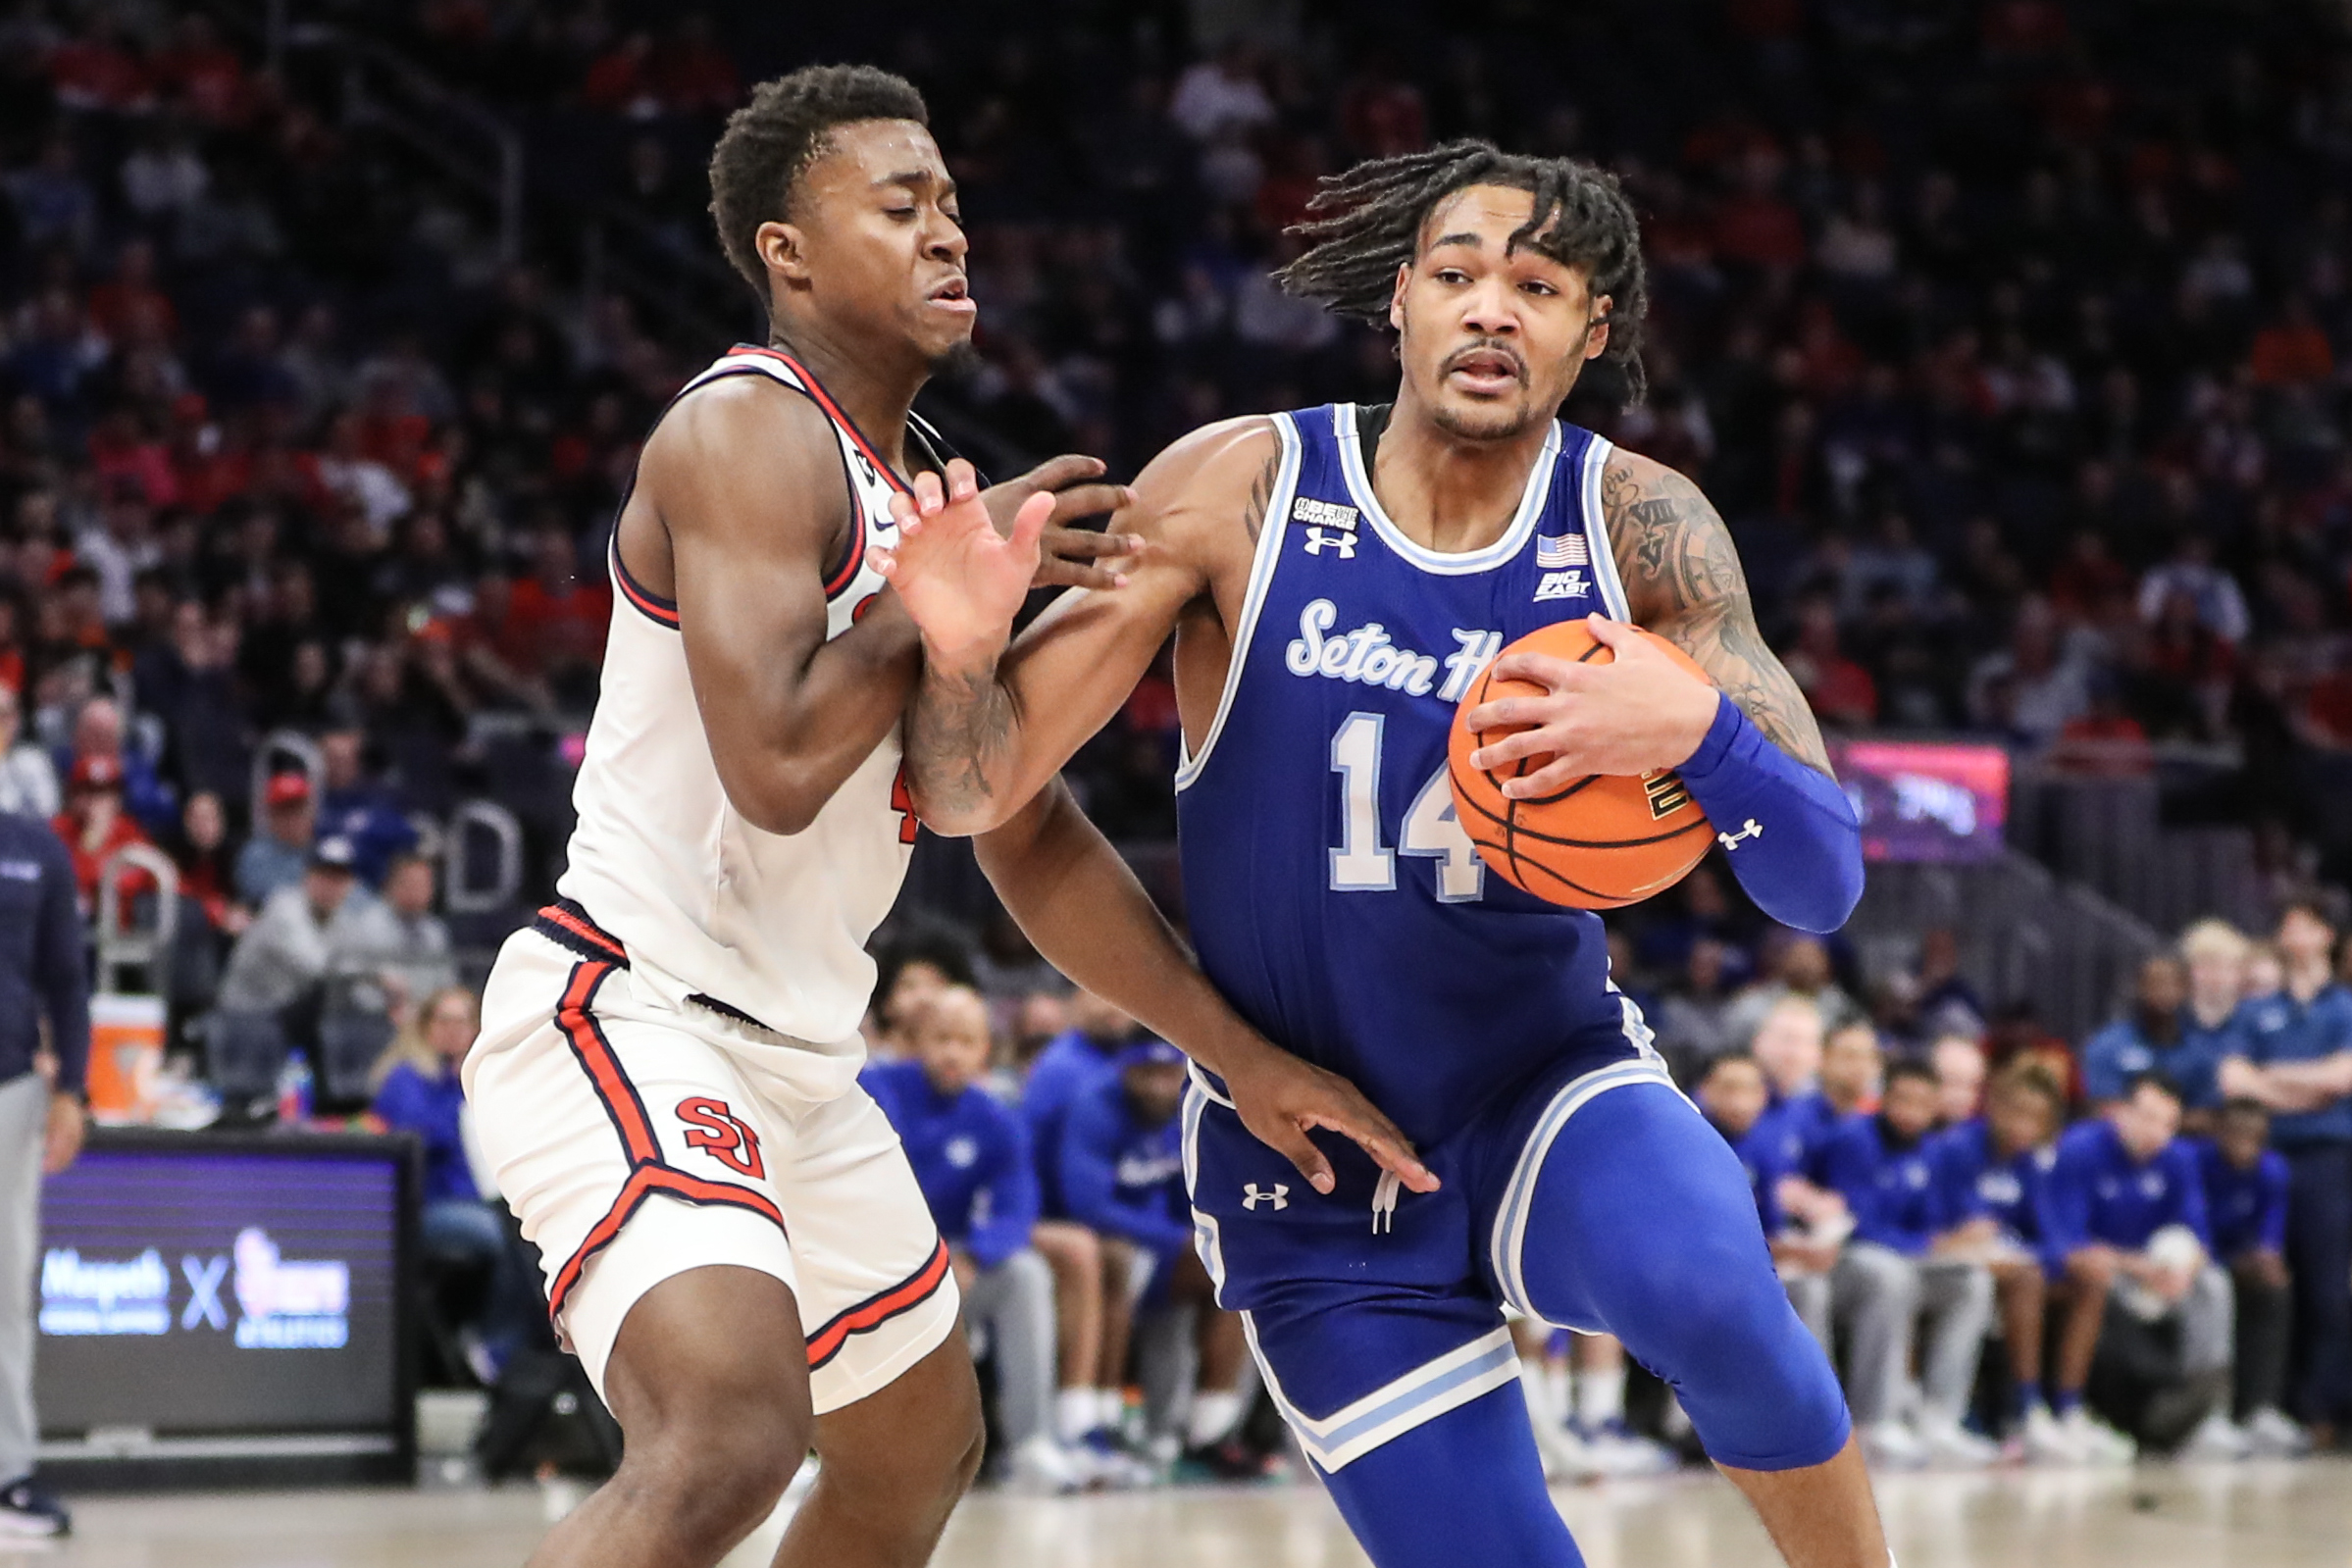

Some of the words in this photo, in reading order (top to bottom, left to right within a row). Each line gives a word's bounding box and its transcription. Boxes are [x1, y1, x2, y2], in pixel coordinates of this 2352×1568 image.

[1293, 510, 1356, 531] CHANGE
[1540, 570, 1581, 584] BIG
[1535, 582, 1591, 595] EAST
[1286, 598, 1438, 696] Seton
[1328, 711, 1486, 903] 14
